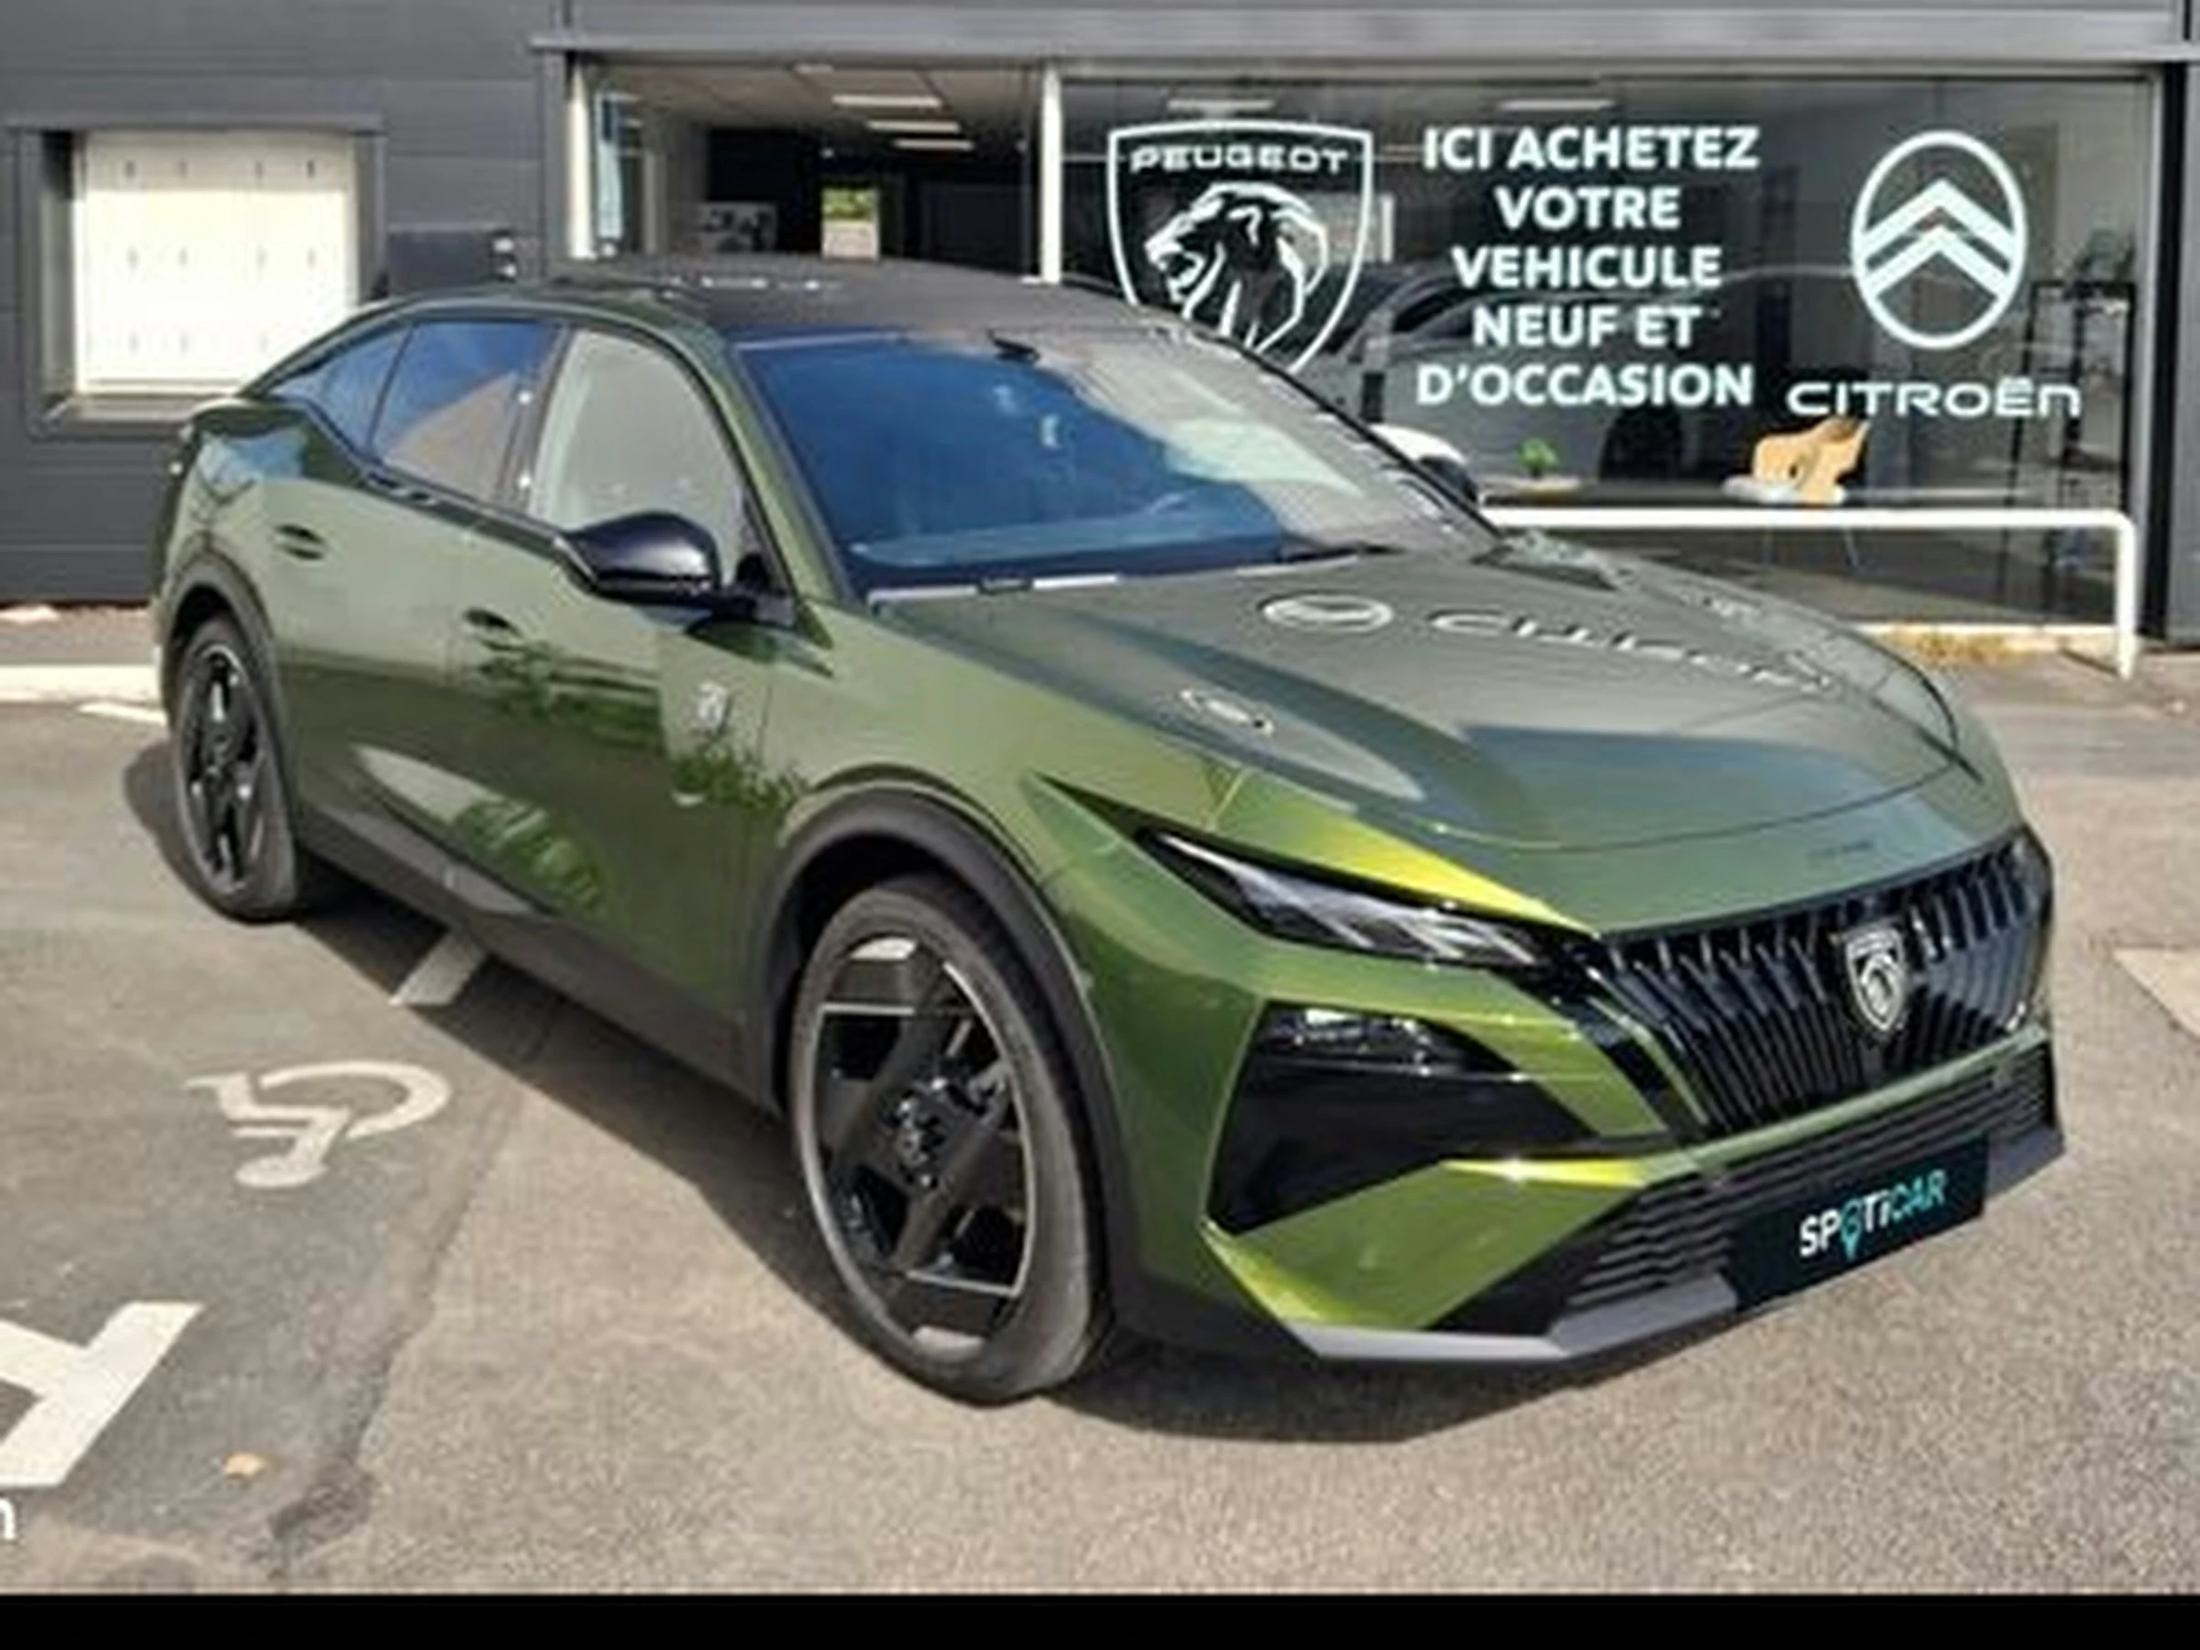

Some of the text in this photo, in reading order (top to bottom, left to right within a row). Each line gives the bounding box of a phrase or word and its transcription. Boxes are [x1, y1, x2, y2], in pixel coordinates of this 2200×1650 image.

[1129, 143, 1349, 175] PEUGEOT
[1422, 125, 1760, 170] ICI ACHETEZ
[1493, 186, 1681, 229] VOTRE
[1451, 246, 1722, 289] VEHICULE
[1472, 305, 1701, 348] NEUF ET
[1416, 364, 1754, 408] D'OCCASION
